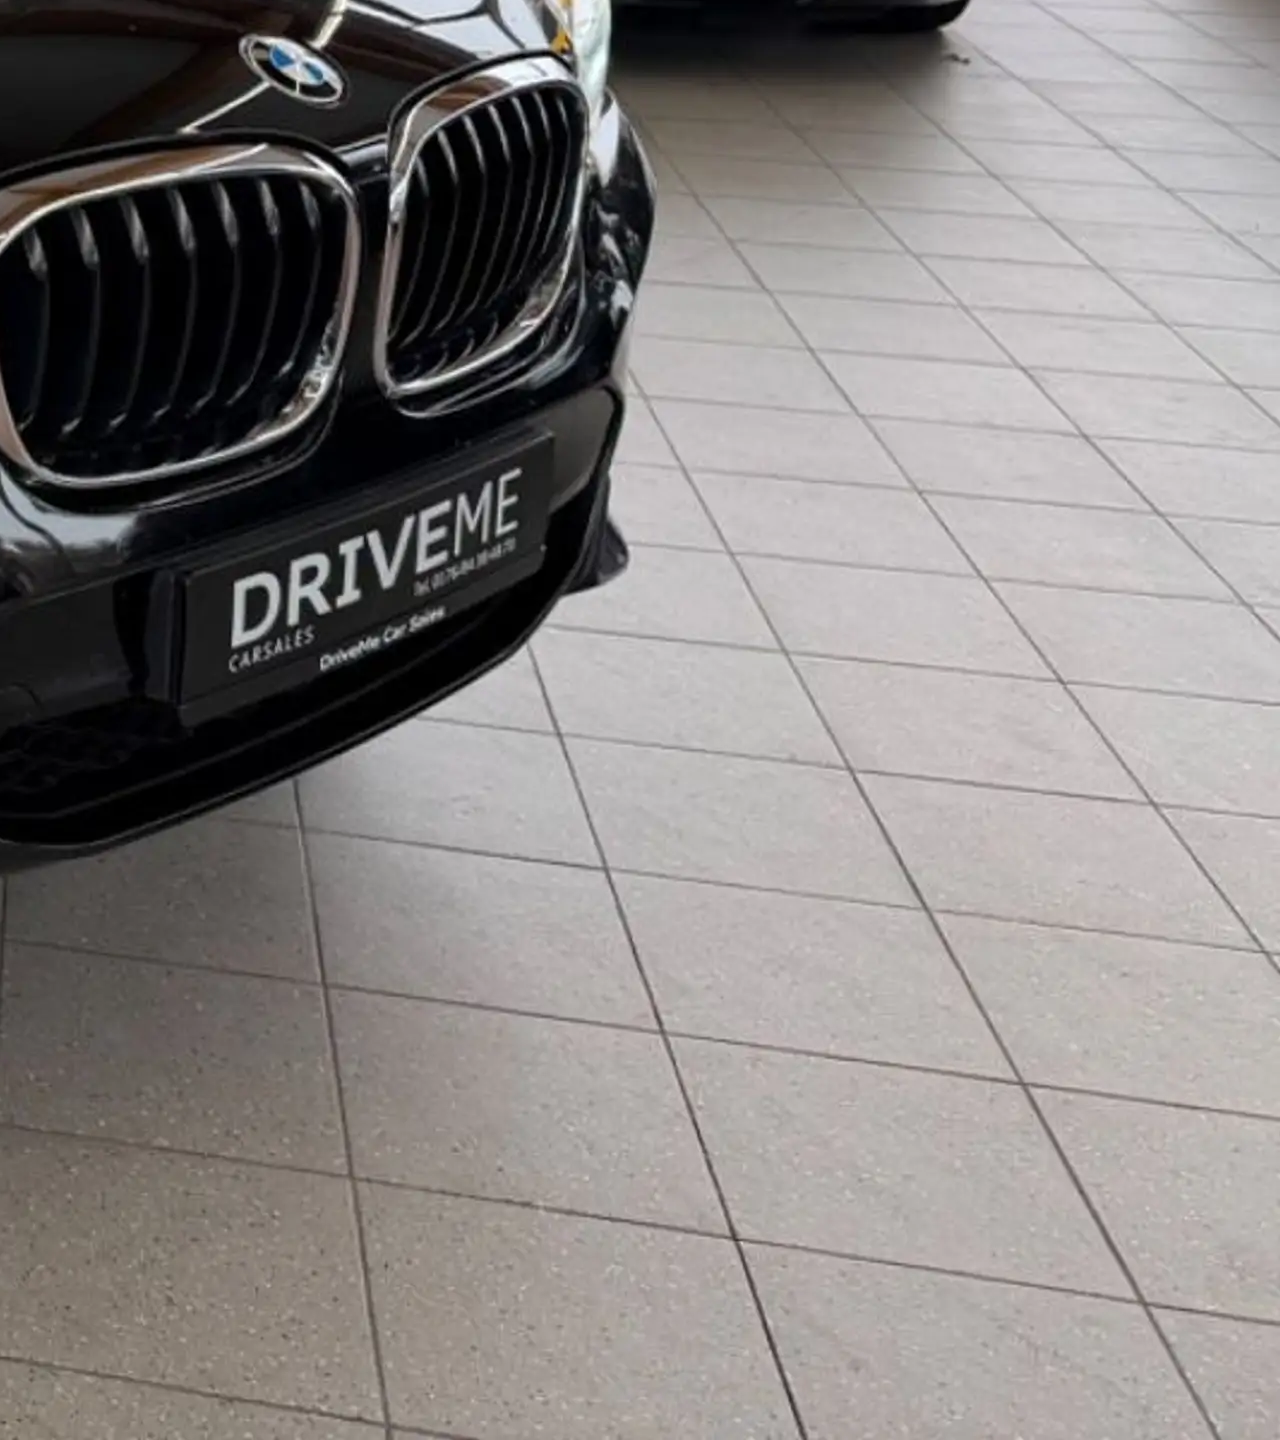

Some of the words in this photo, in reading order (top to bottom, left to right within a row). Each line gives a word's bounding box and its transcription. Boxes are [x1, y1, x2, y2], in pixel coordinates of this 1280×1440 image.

[230, 467, 522, 649] DRIVEME
[228, 624, 315, 673] CARSALES
[382, 617, 407, 643] Car
